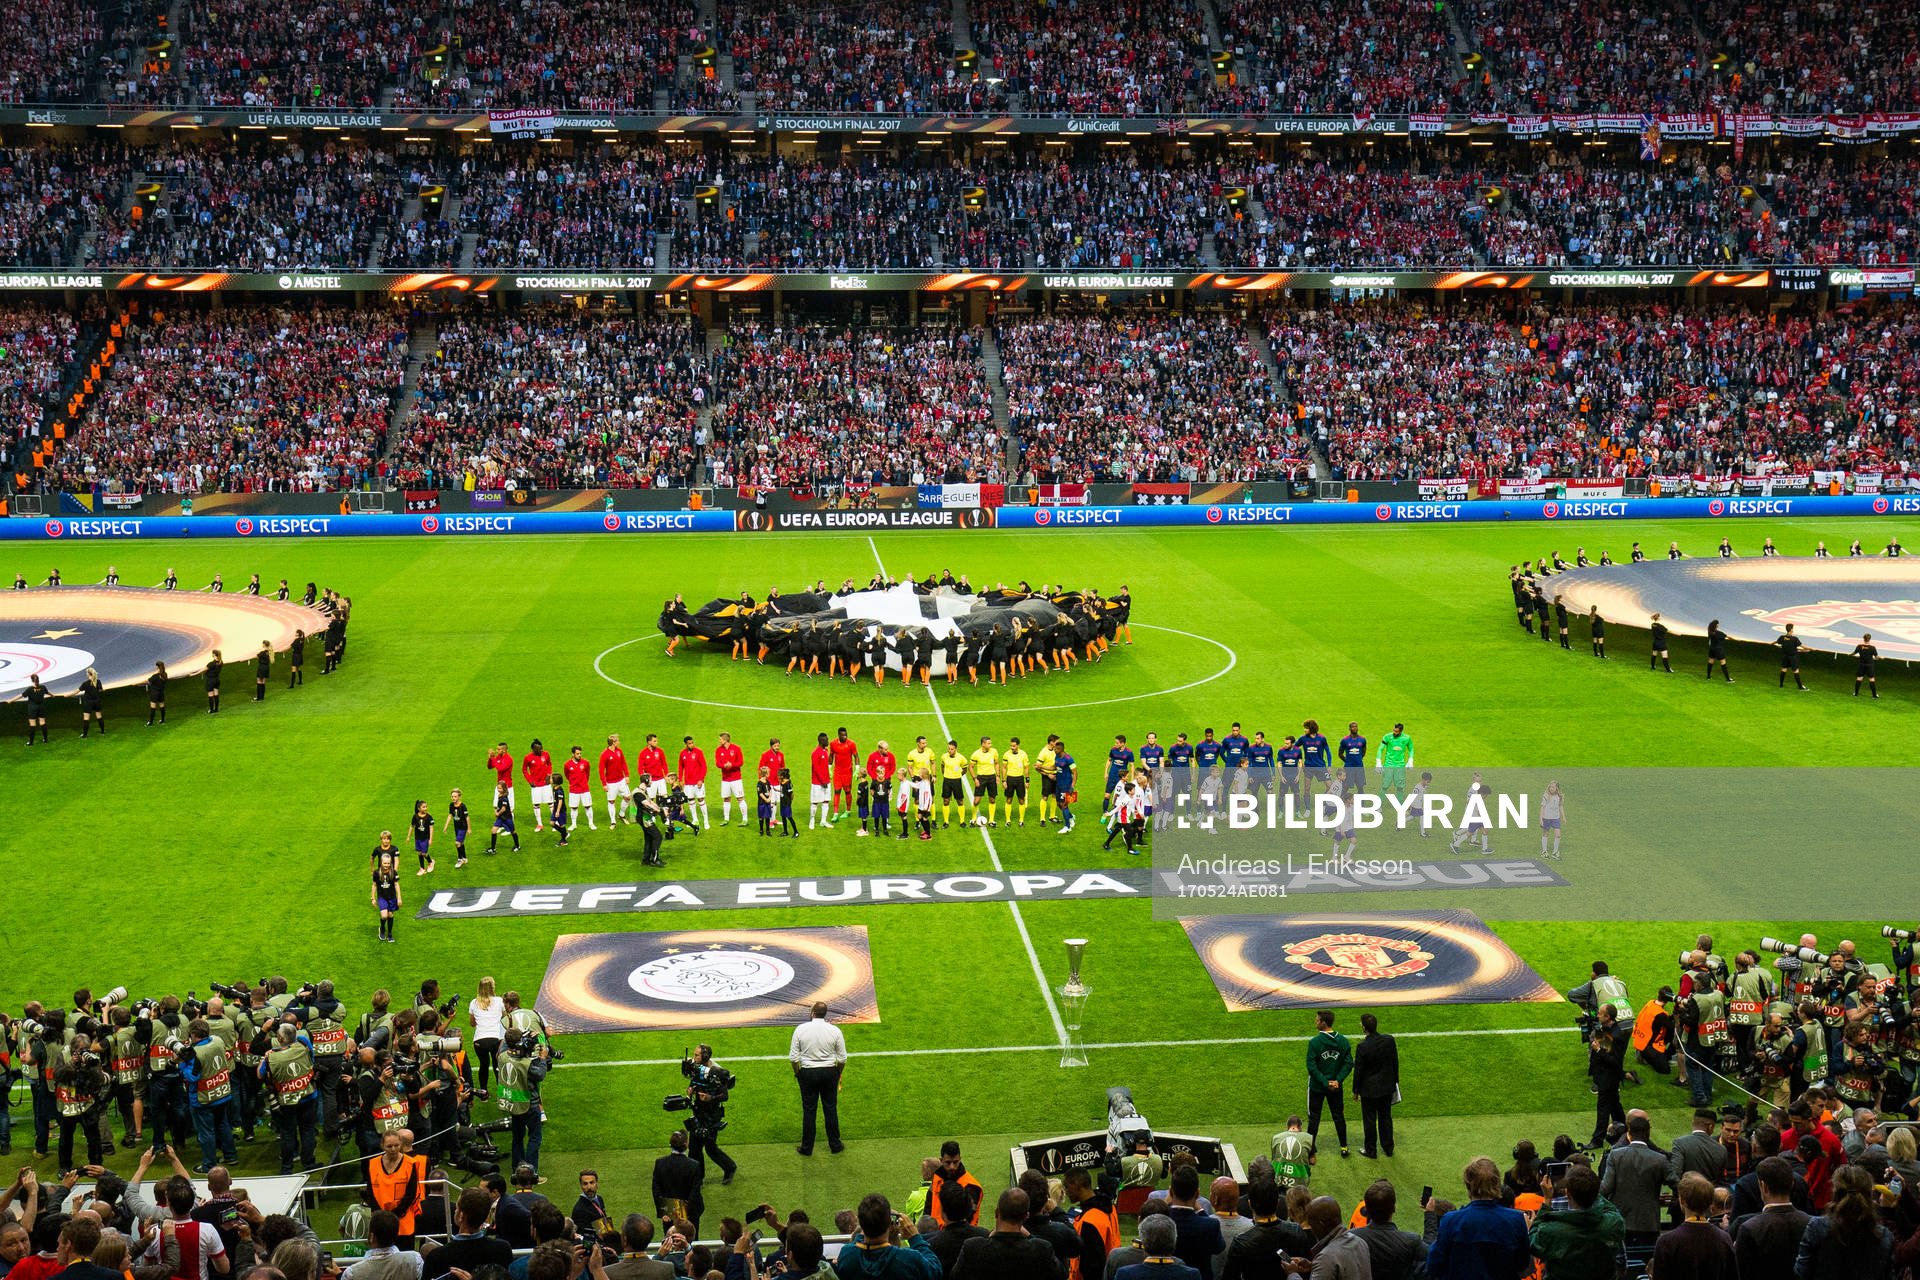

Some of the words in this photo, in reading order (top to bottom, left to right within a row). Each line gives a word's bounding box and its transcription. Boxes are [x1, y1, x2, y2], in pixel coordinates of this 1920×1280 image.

[28, 111, 66, 123] FedEx
[248, 114, 281, 126] UEFA
[284, 115, 331, 126] EUROPA
[334, 116, 382, 127] LEAGUE
[490, 109, 552, 120] SCOREBOARD
[1668, 114, 1711, 122] BELIEE
[503, 121, 518, 130] MU
[526, 120, 540, 128] FC
[776, 119, 842, 130] STOCKHOLM
[845, 119, 876, 130] FINAL
[878, 119, 901, 130] 2017
[1079, 120, 1120, 132] UniCredit
[1275, 120, 1303, 132] UEFA
[1305, 121, 1350, 132] EUROPA
[1352, 121, 1396, 132] LAGUE
[1667, 124, 1685, 132] MU
[1697, 123, 1711, 131] FC
[512, 131, 536, 140] REDS
[1794, 269, 1822, 277] STUCK
[0, 276, 47, 288] EUROPA
[50, 276, 103, 288] LEAGUE
[293, 276, 341, 288] AMSTEL
[516, 277, 588, 289] STOCKHOLM
[591, 277, 624, 289] FINAL
[627, 277, 652, 289] 2017
[830, 276, 868, 289] FedEx
[1044, 277, 1077, 288] UEFA
[1079, 277, 1125, 288] EUROPA
[1127, 277, 1174, 288] LEAGUE
[1549, 275, 1617, 286] STOCKHOLM
[1620, 274, 1649, 285] FINAL
[1651, 274, 1675, 285] 2017
[1781, 280, 1790, 289] IN
[1397, 504, 1461, 518] RESPECT
[1564, 502, 1628, 516] RESPECT
[1729, 500, 1793, 514] RESPECT
[780, 514, 822, 527] UEFA
[826, 513, 888, 527] EUROPA
[891, 512, 953, 526] LEAGUE
[1057, 509, 1122, 523] RESPECT
[1228, 507, 1291, 522] RESPECT
[70, 520, 142, 535] RESPECT
[260, 519, 331, 534] RESPECT
[444, 517, 514, 532] RESPECT
[626, 515, 694, 529] RESPECT
[428, 885, 704, 914] UEFA
[737, 872, 1139, 904] EUROPA
[1159, 862, 1554, 893] LEAGUE
[1292, 935, 1417, 953] MANCHESTER
[640, 954, 707, 976] AJAX
[1331, 965, 1412, 977] UNITED
[1730, 1002, 1756, 1012] HOTO
[206, 1070, 229, 1088] PHOT
[282, 1074, 313, 1091] PHOT
[1073, 1142, 1092, 1153] UEFA
[1066, 1151, 1101, 1164] EUROPA
